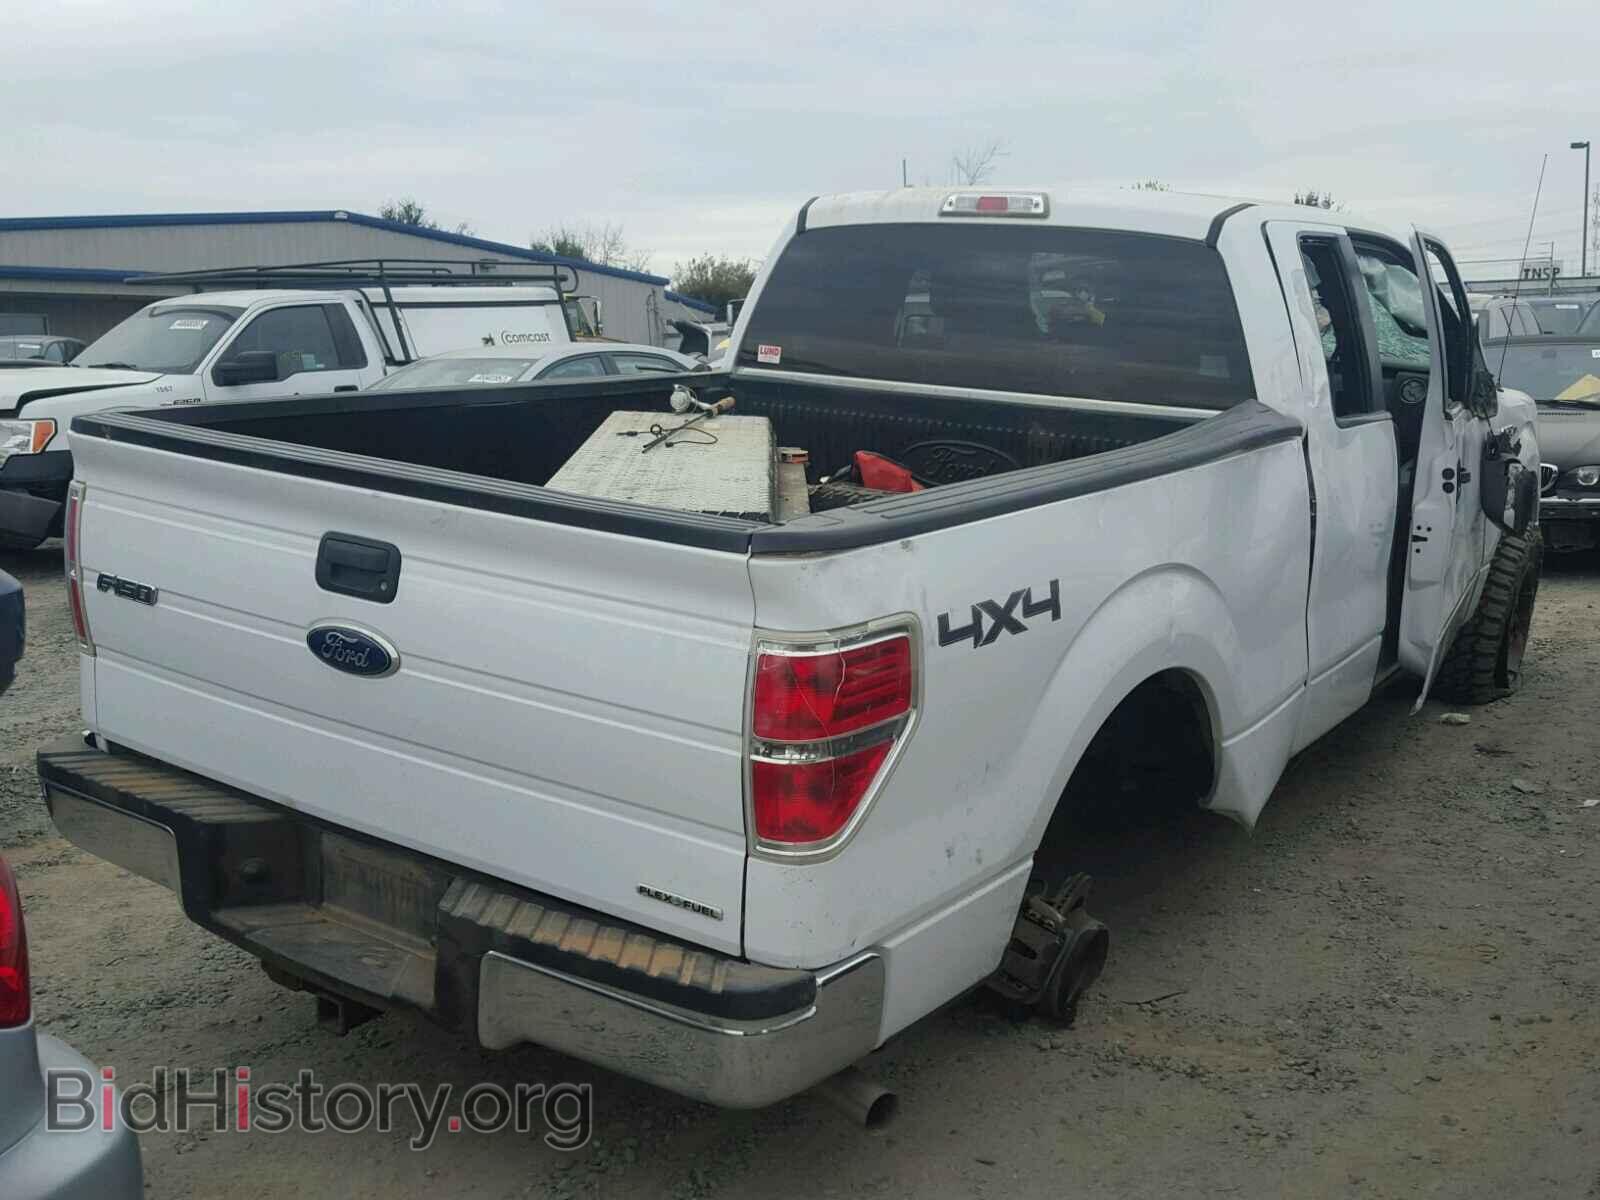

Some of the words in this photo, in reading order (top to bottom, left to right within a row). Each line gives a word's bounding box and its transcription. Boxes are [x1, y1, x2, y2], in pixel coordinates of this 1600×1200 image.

[501, 331, 551, 344] comcast
[322, 631, 370, 668] Ford
[638, 885, 673, 904] FLEX
[683, 900, 722, 920] FUEL
